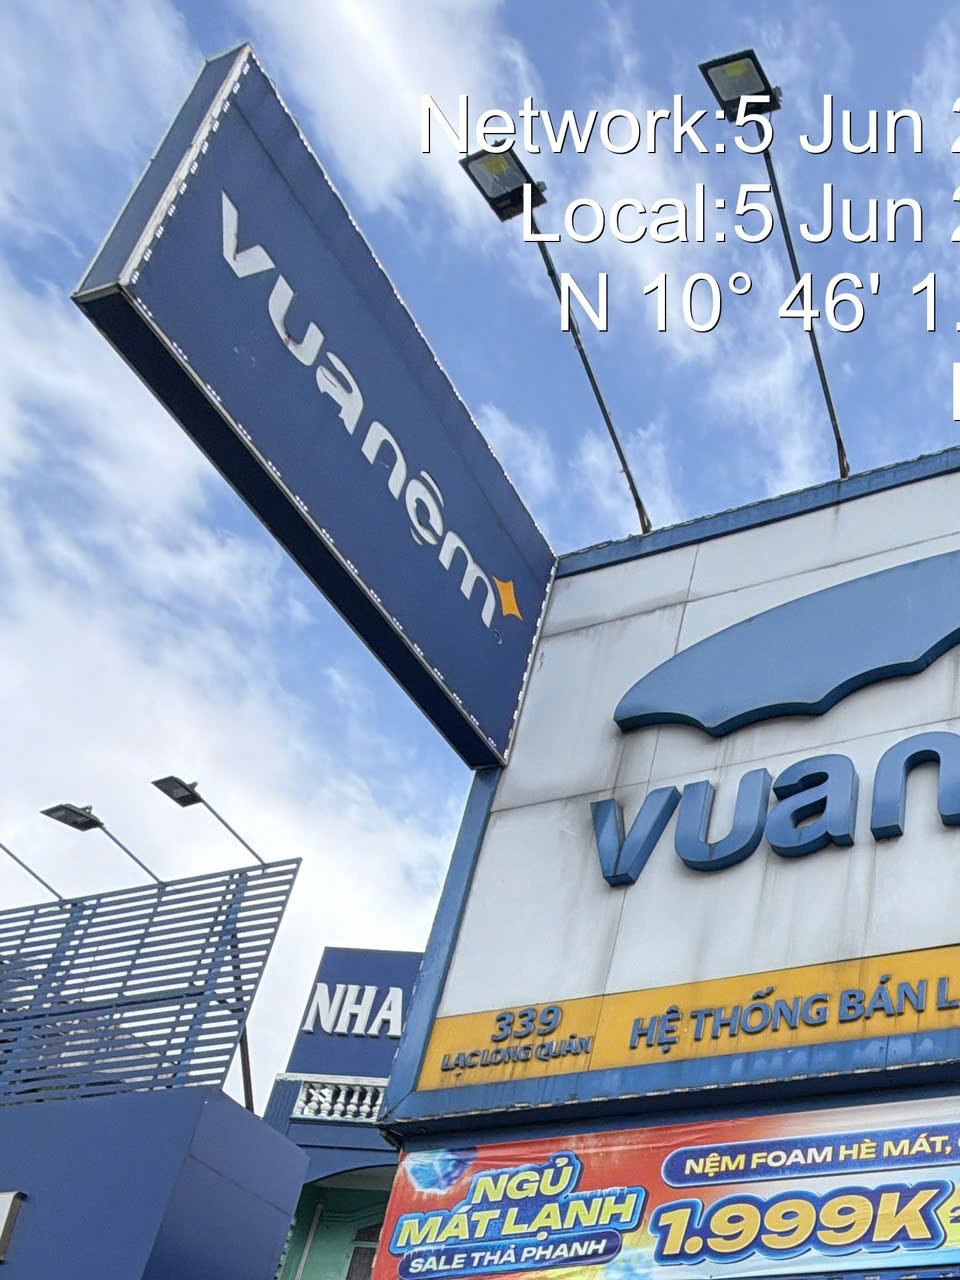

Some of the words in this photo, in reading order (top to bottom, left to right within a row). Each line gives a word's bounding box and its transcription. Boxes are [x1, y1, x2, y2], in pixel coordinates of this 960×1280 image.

[301, 982, 403, 1039] NHA
[491, 1005, 563, 1043] 339
[629, 1004, 682, 1054] HỆ
[690, 985, 830, 1042] THỐNG
[838, 974, 928, 1025] BÁN
[440, 1049, 482, 1078] LẠC
[480, 1044, 533, 1067] LONG
[535, 1033, 593, 1062] QUÂN
[684, 1152, 746, 1176] NỆM
[750, 1145, 833, 1169] FOAM
[838, 1137, 877, 1161] HÈ
[882, 1132, 952, 1159] MÁT,
[471, 1156, 574, 1205] NGỦ
[395, 1205, 502, 1248] MÁT
[501, 1193, 639, 1242] LẠNH
[657, 1186, 943, 1257] 1.999K
[408, 1252, 471, 1274] SALE
[471, 1243, 517, 1267] THẢ
[520, 1238, 608, 1263] PHANH
